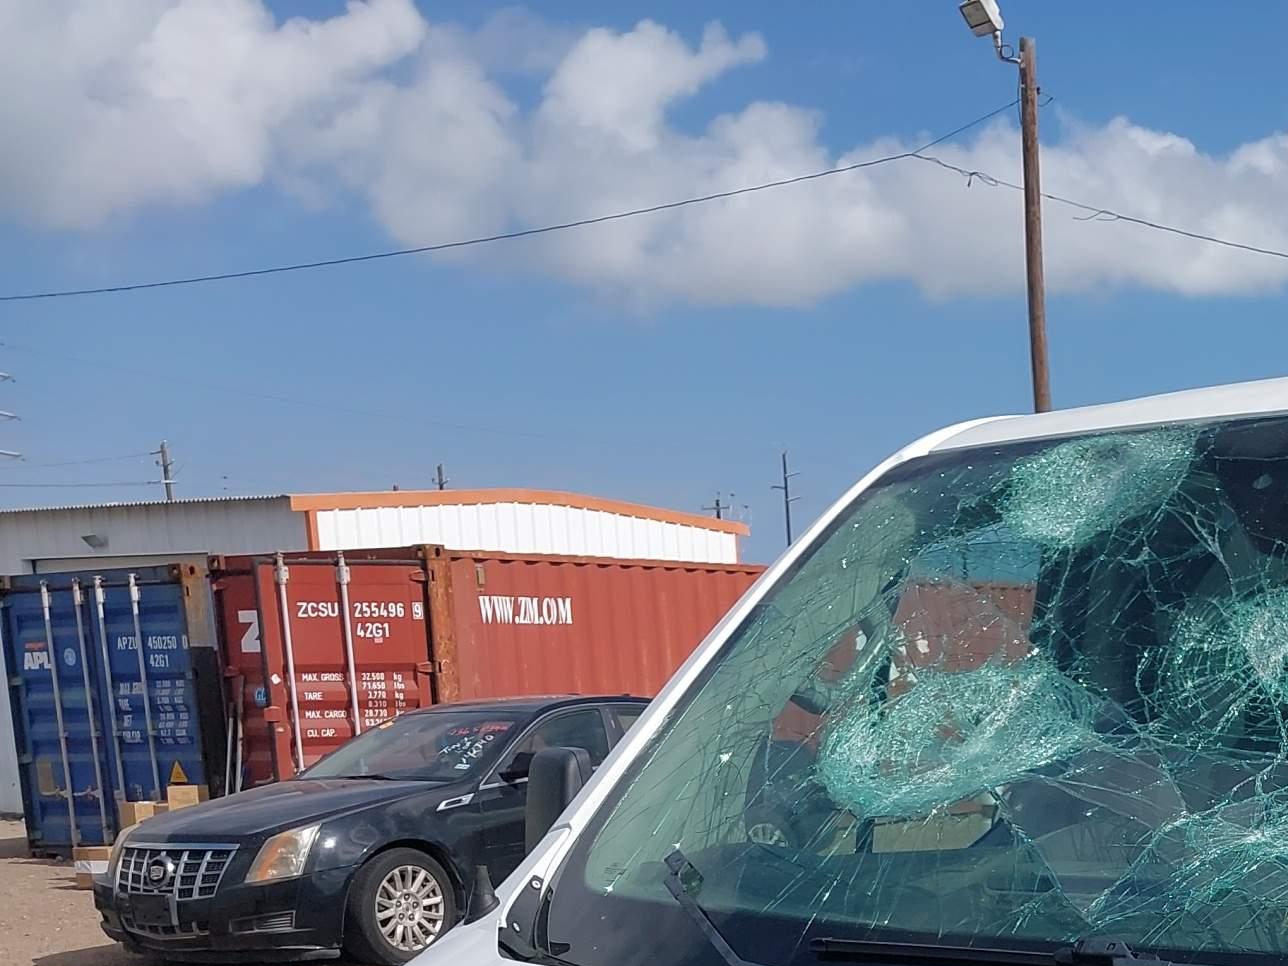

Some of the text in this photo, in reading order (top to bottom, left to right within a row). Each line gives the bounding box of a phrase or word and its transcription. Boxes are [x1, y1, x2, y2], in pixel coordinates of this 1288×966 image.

[296, 602, 423, 619] ZCSU 255496 9
[356, 622, 390, 638] 42G1
[117, 636, 138, 650] APZU
[148, 635, 177, 649] 450250
[24, 651, 52, 670] APL
[150, 654, 169, 668] 42G1
[302, 672, 320, 682] MAX.
[321, 672, 344, 682] GROSS
[393, 672, 402, 682] kg
[304, 692, 324, 701] TARE
[394, 690, 404, 701] kg
[305, 710, 323, 719] MAX.
[324, 710, 347, 719] CARGO
